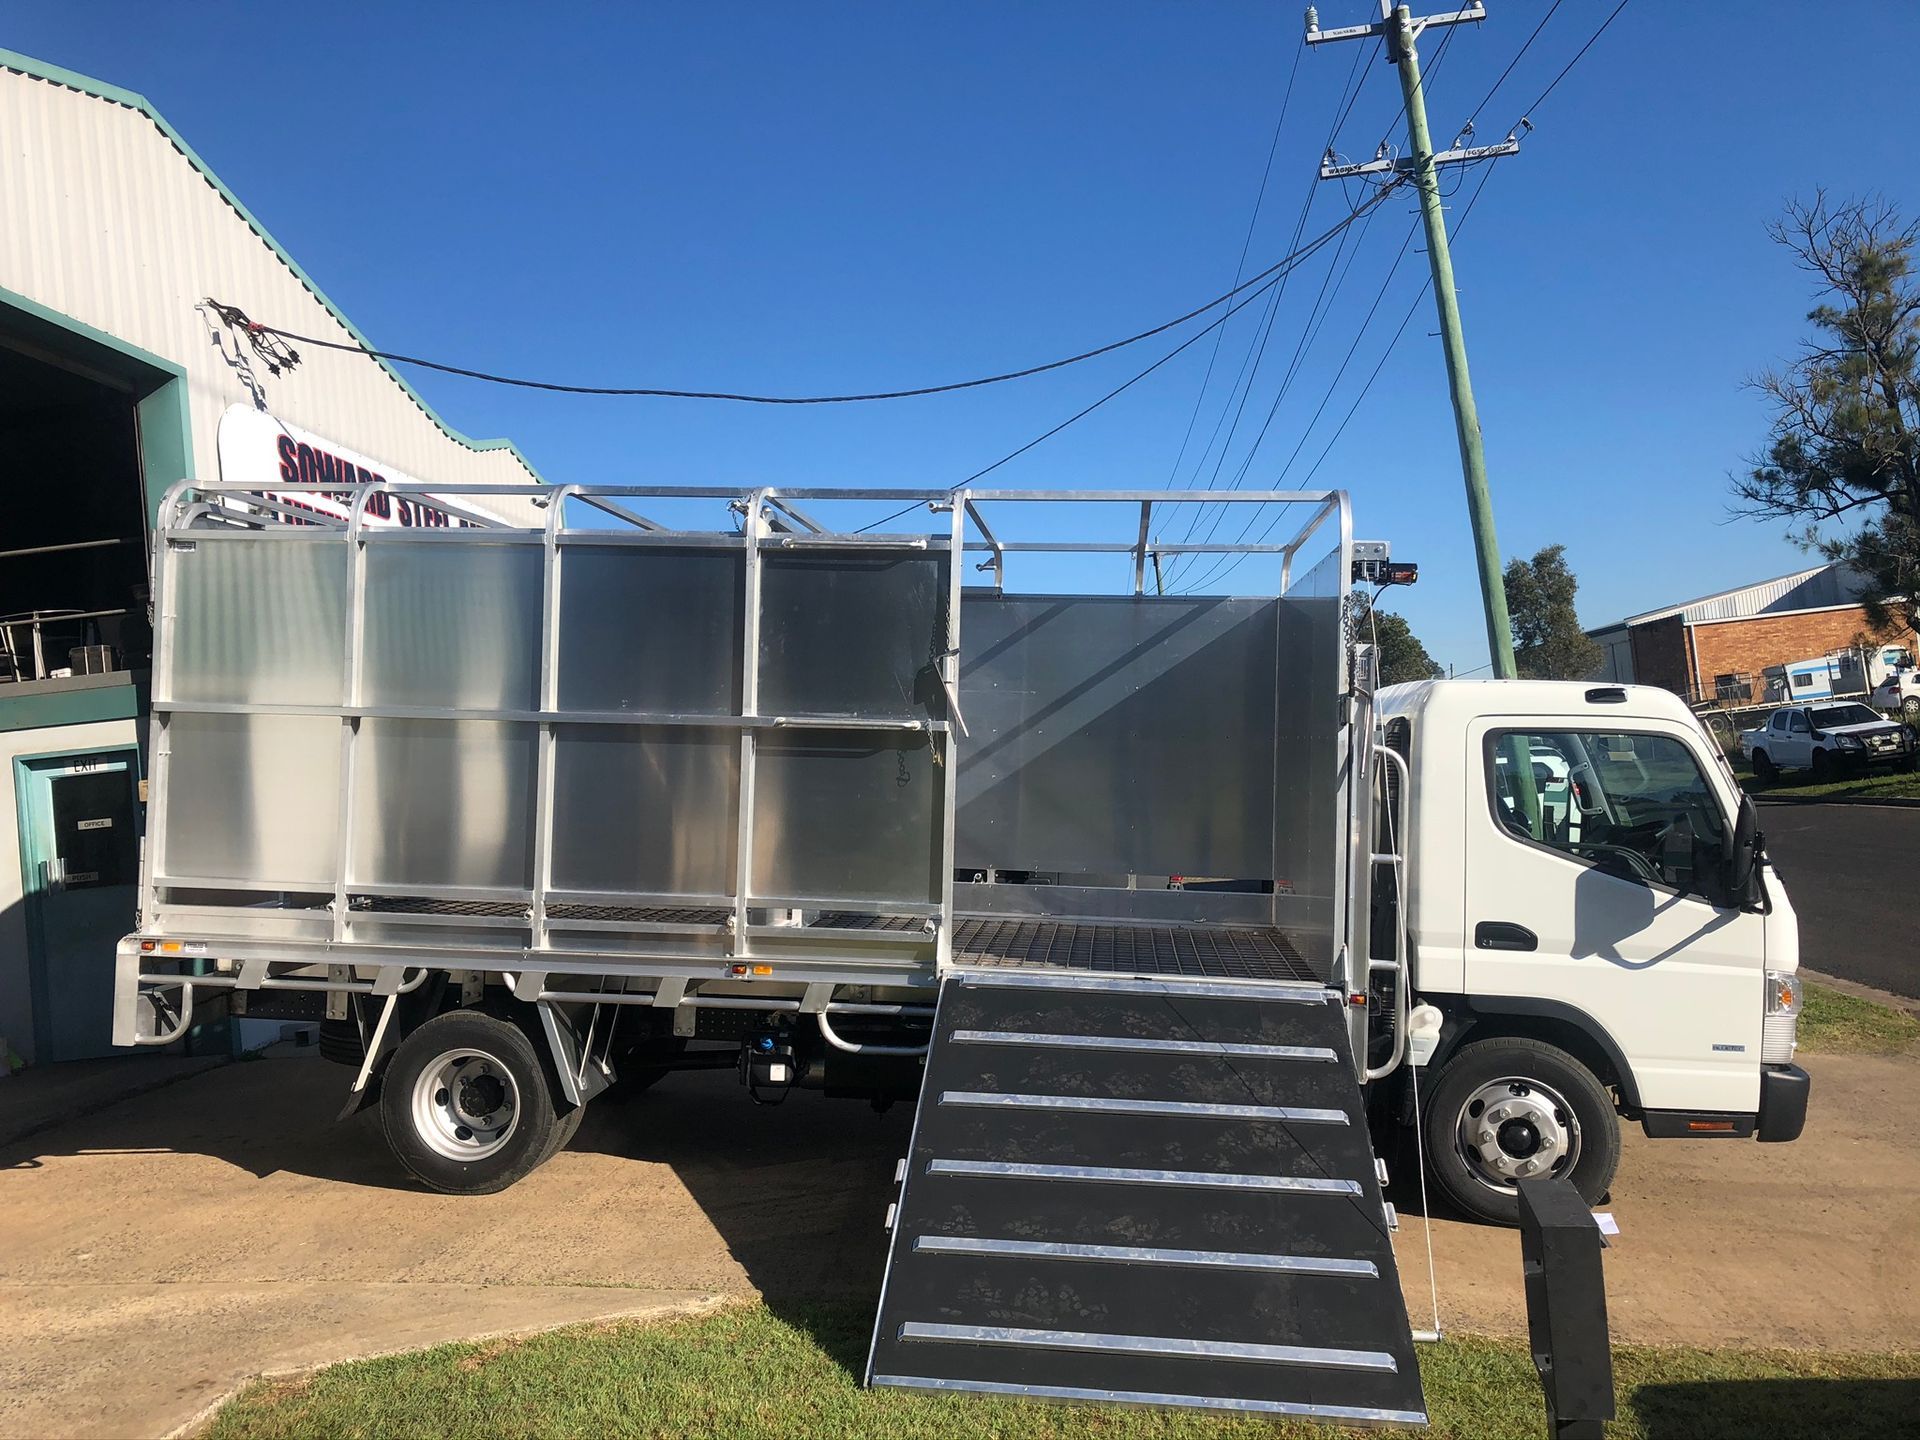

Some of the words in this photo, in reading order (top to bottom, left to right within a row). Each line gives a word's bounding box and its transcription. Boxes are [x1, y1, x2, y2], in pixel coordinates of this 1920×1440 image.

[277, 433, 391, 521] SOWARD
[74, 758, 97, 773] EXIT
[84, 820, 105, 828] OFFICE
